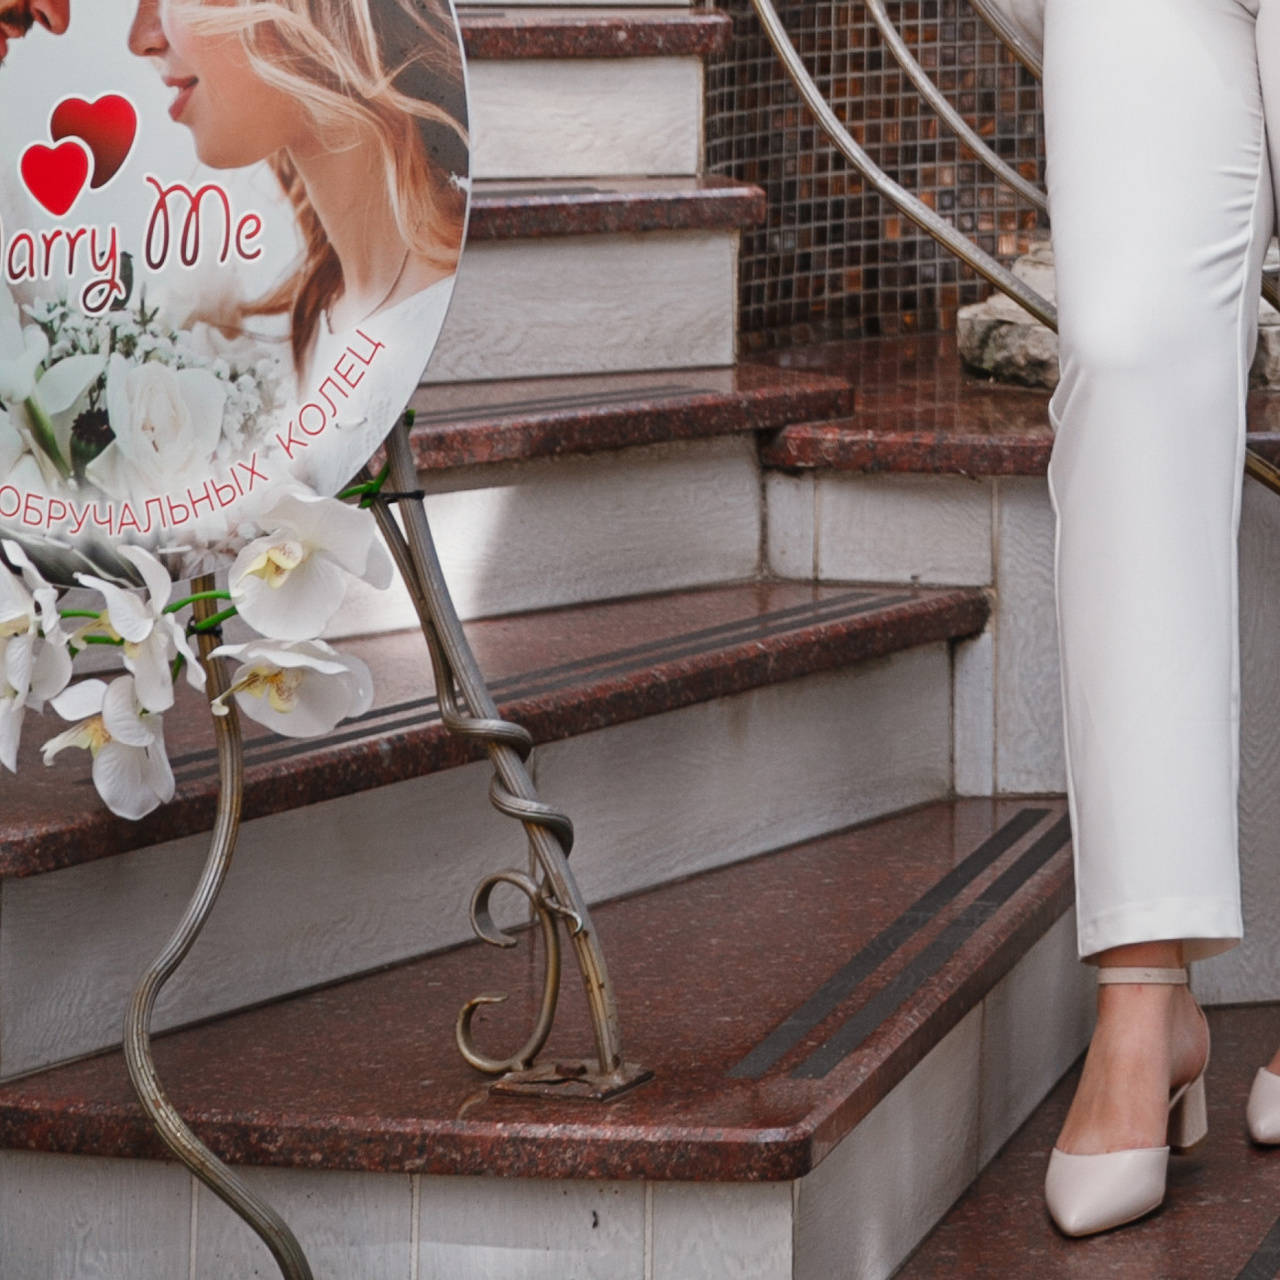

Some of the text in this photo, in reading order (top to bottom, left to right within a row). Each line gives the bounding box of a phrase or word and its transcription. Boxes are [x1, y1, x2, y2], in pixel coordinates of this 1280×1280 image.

[0, 175, 263, 313] arry Me
[0, 328, 386, 536] ОБРУЧАЛЬНЫХ КОЛЕЦ
